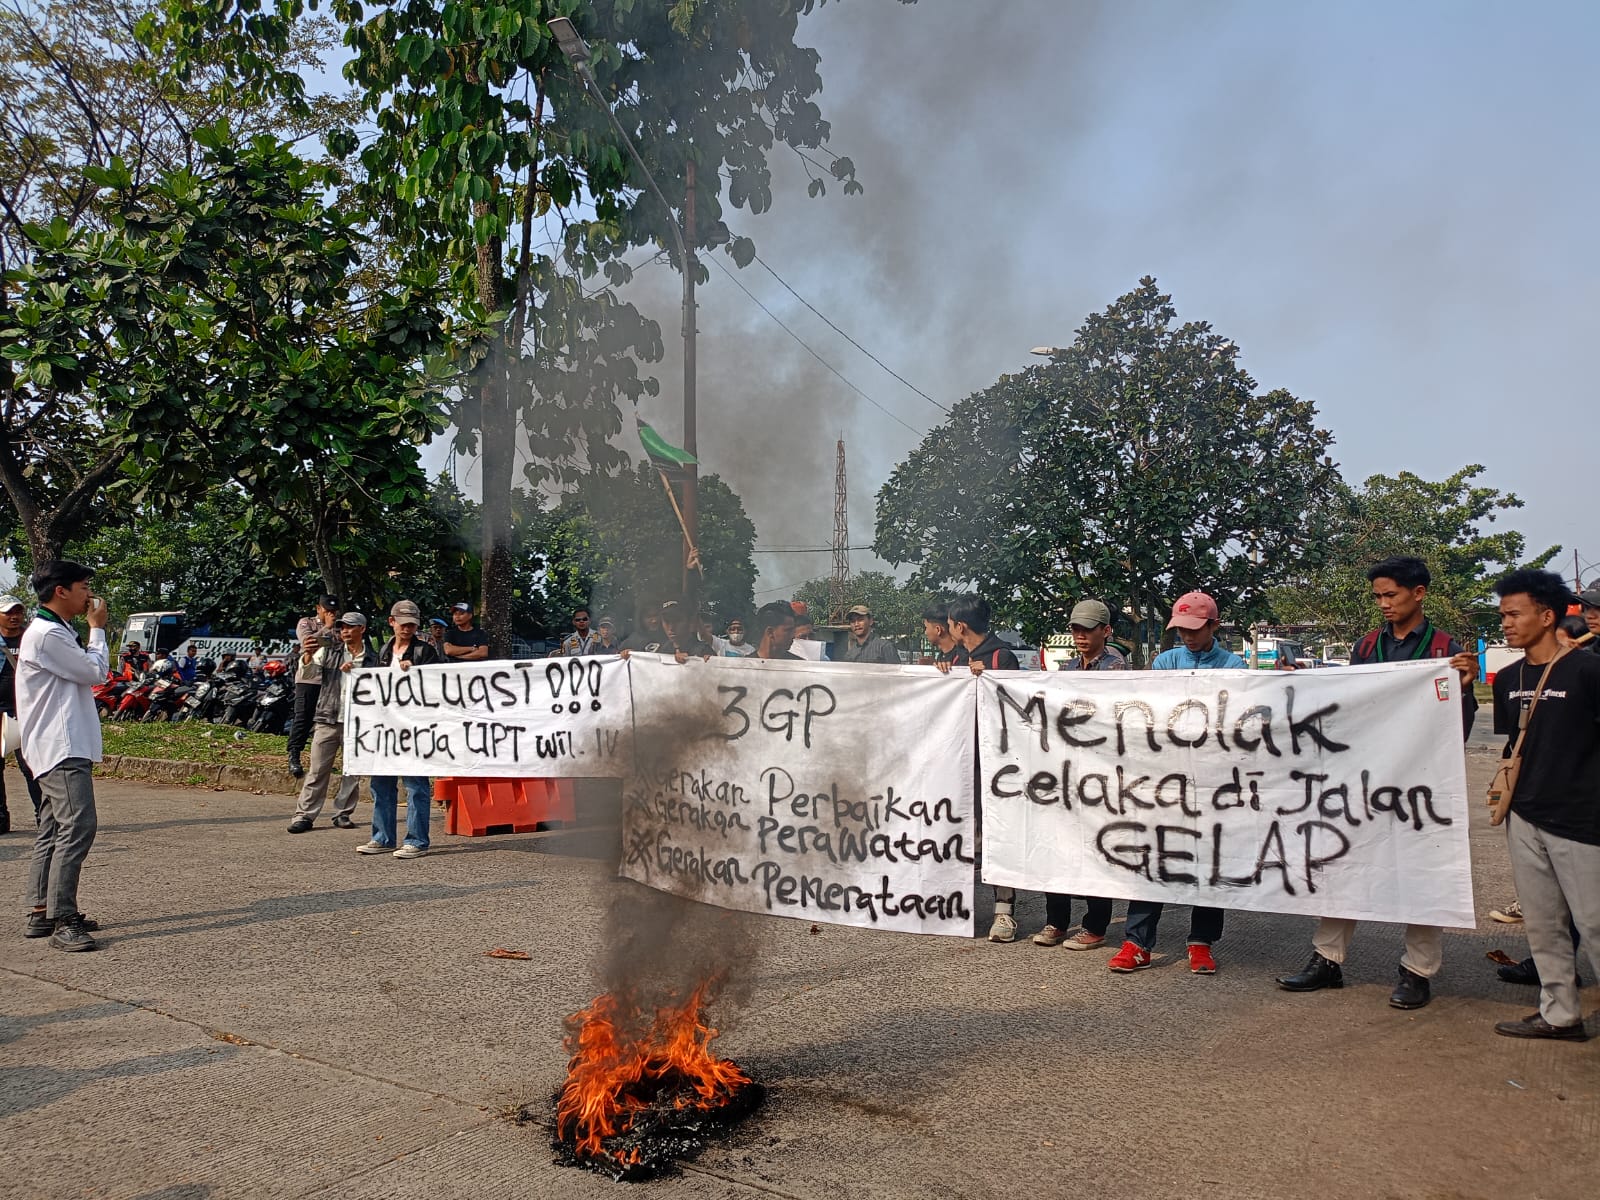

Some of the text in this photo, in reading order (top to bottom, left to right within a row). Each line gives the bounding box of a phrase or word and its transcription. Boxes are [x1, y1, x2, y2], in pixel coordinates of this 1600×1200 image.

[354, 716, 455, 760] kinerja
[462, 721, 527, 762] UPT
[996, 684, 1350, 756] Menolak
[655, 791, 751, 838] Gerakan
[760, 766, 963, 831] Perbaikan
[990, 760, 1453, 831] celaka di Jalan
[656, 829, 750, 885] Gerakan
[1095, 820, 1351, 896] GELAP
